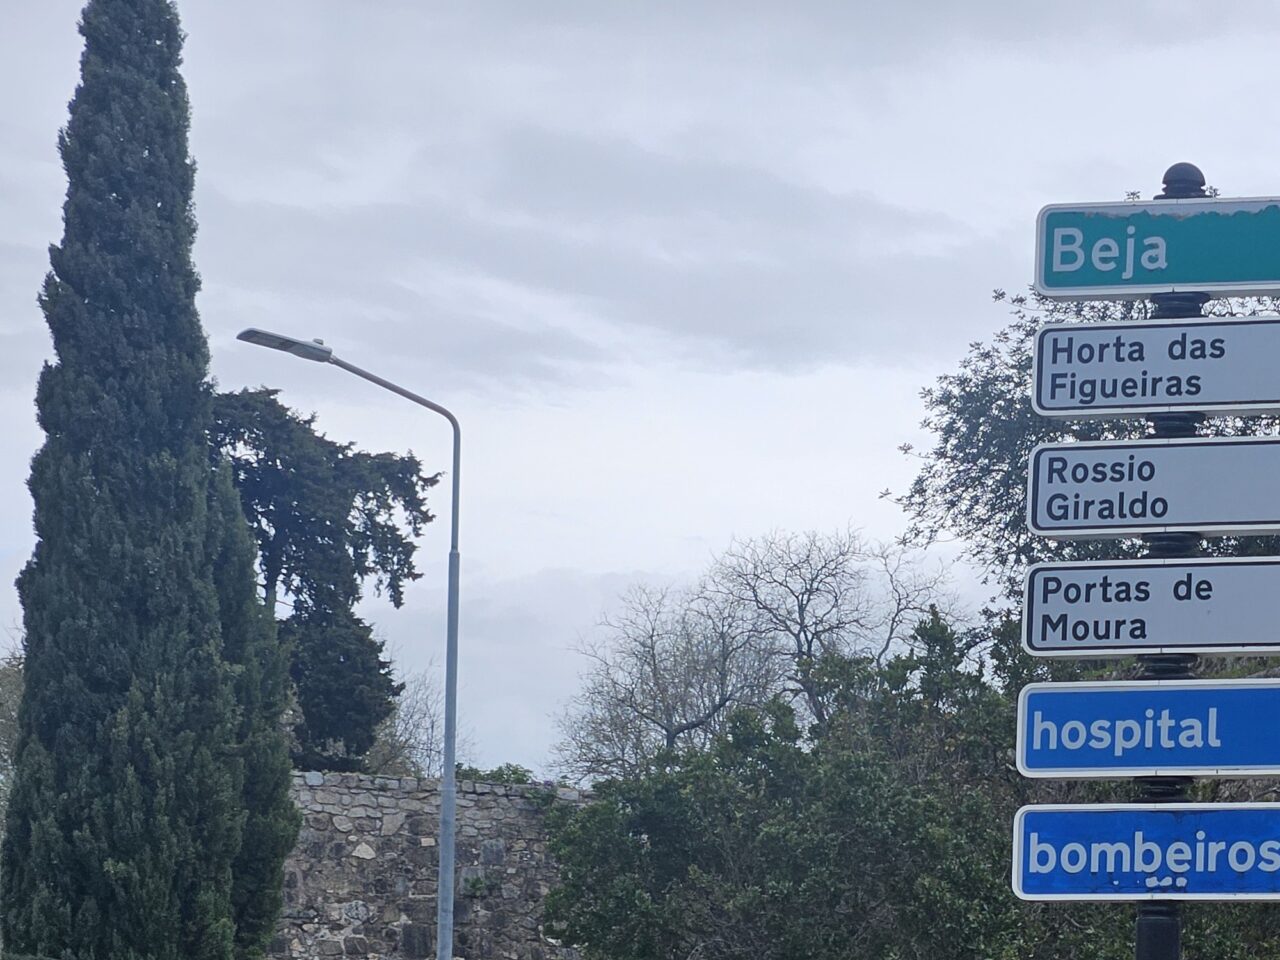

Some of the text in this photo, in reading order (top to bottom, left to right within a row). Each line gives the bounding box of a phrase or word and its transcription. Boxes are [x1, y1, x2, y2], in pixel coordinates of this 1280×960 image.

[1053, 226, 1167, 279] Beja
[1052, 333, 1225, 364] Horta das
[1050, 371, 1202, 404] Figueiras
[1048, 455, 1155, 484] Rossio
[1047, 491, 1168, 521] Giraldo
[1042, 573, 1213, 605] Portas de
[1041, 614, 1147, 642] Moura
[1033, 708, 1221, 756] hospital
